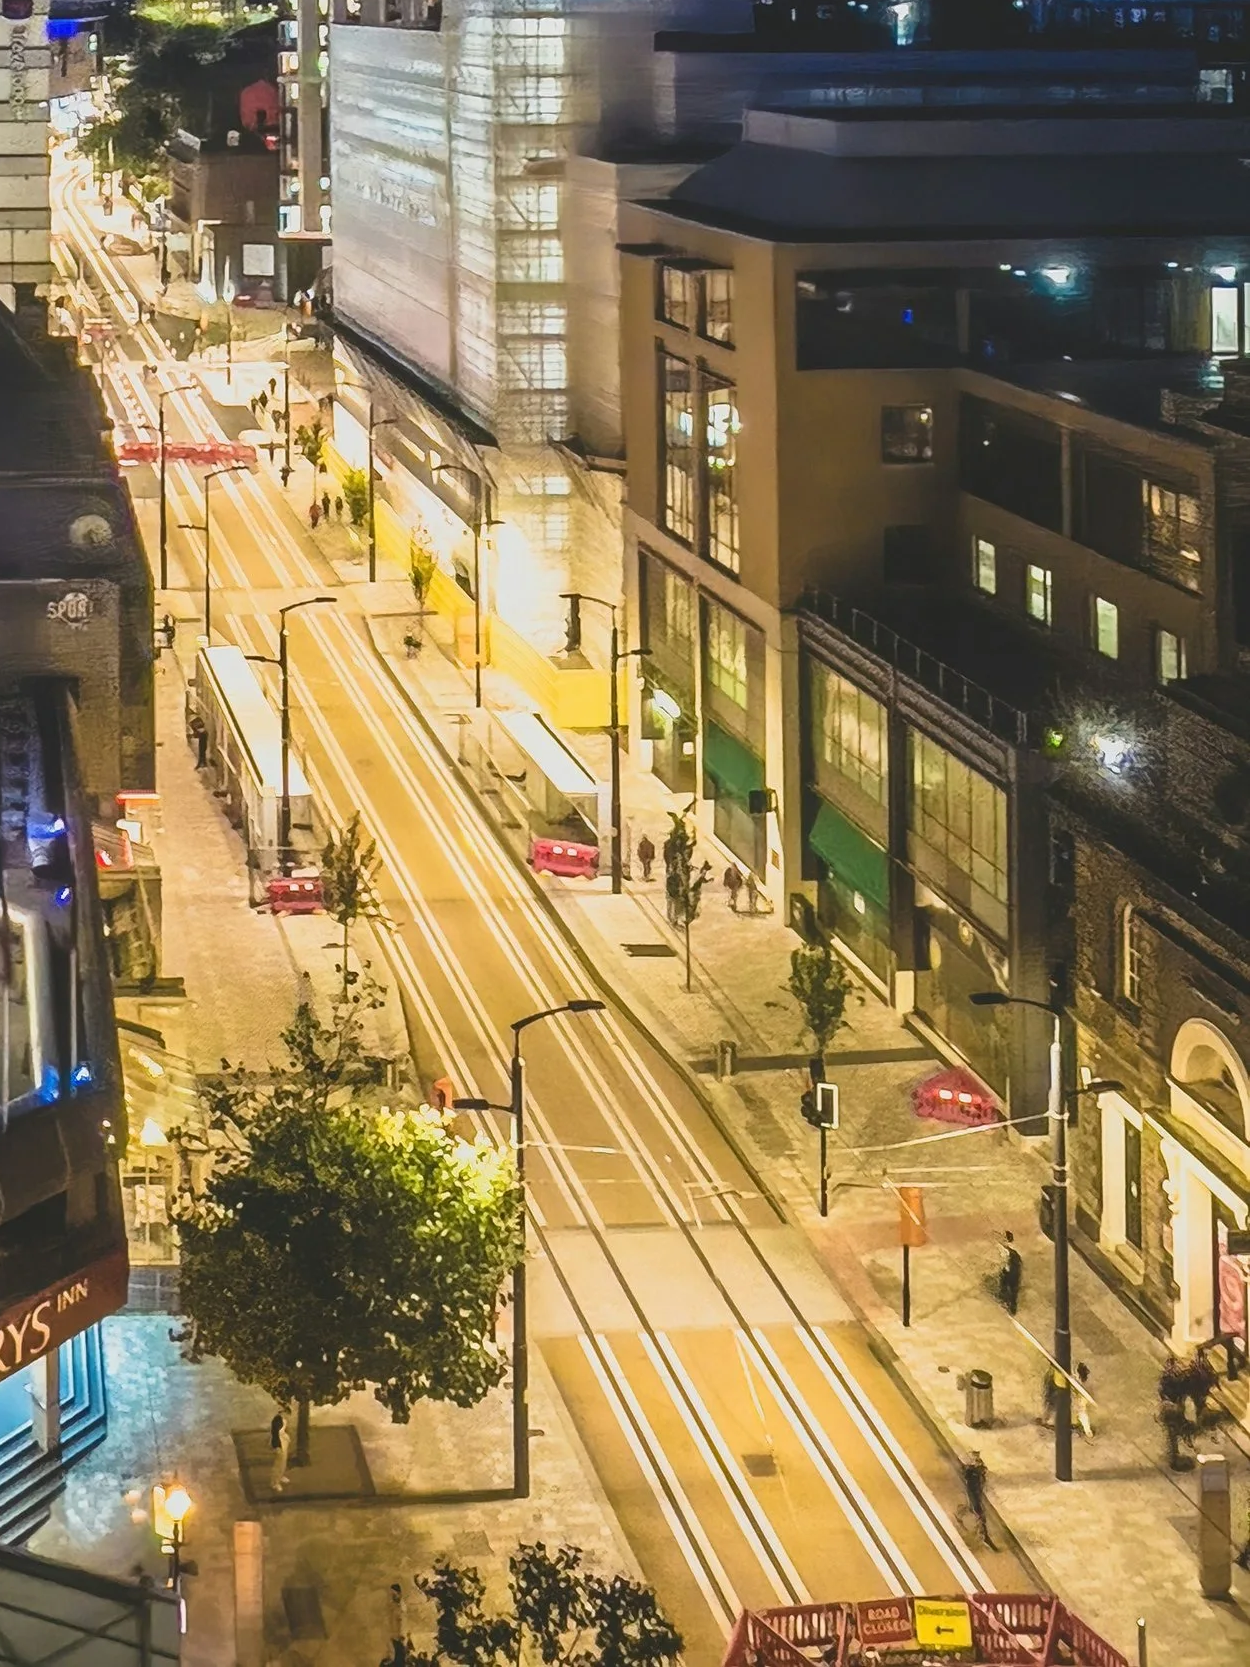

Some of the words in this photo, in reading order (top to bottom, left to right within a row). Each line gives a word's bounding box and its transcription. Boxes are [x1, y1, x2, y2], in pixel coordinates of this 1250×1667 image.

[56, 1280, 88, 1314] INN
[868, 1606, 900, 1621] ROAD
[862, 1618, 912, 1635] CLOSED
